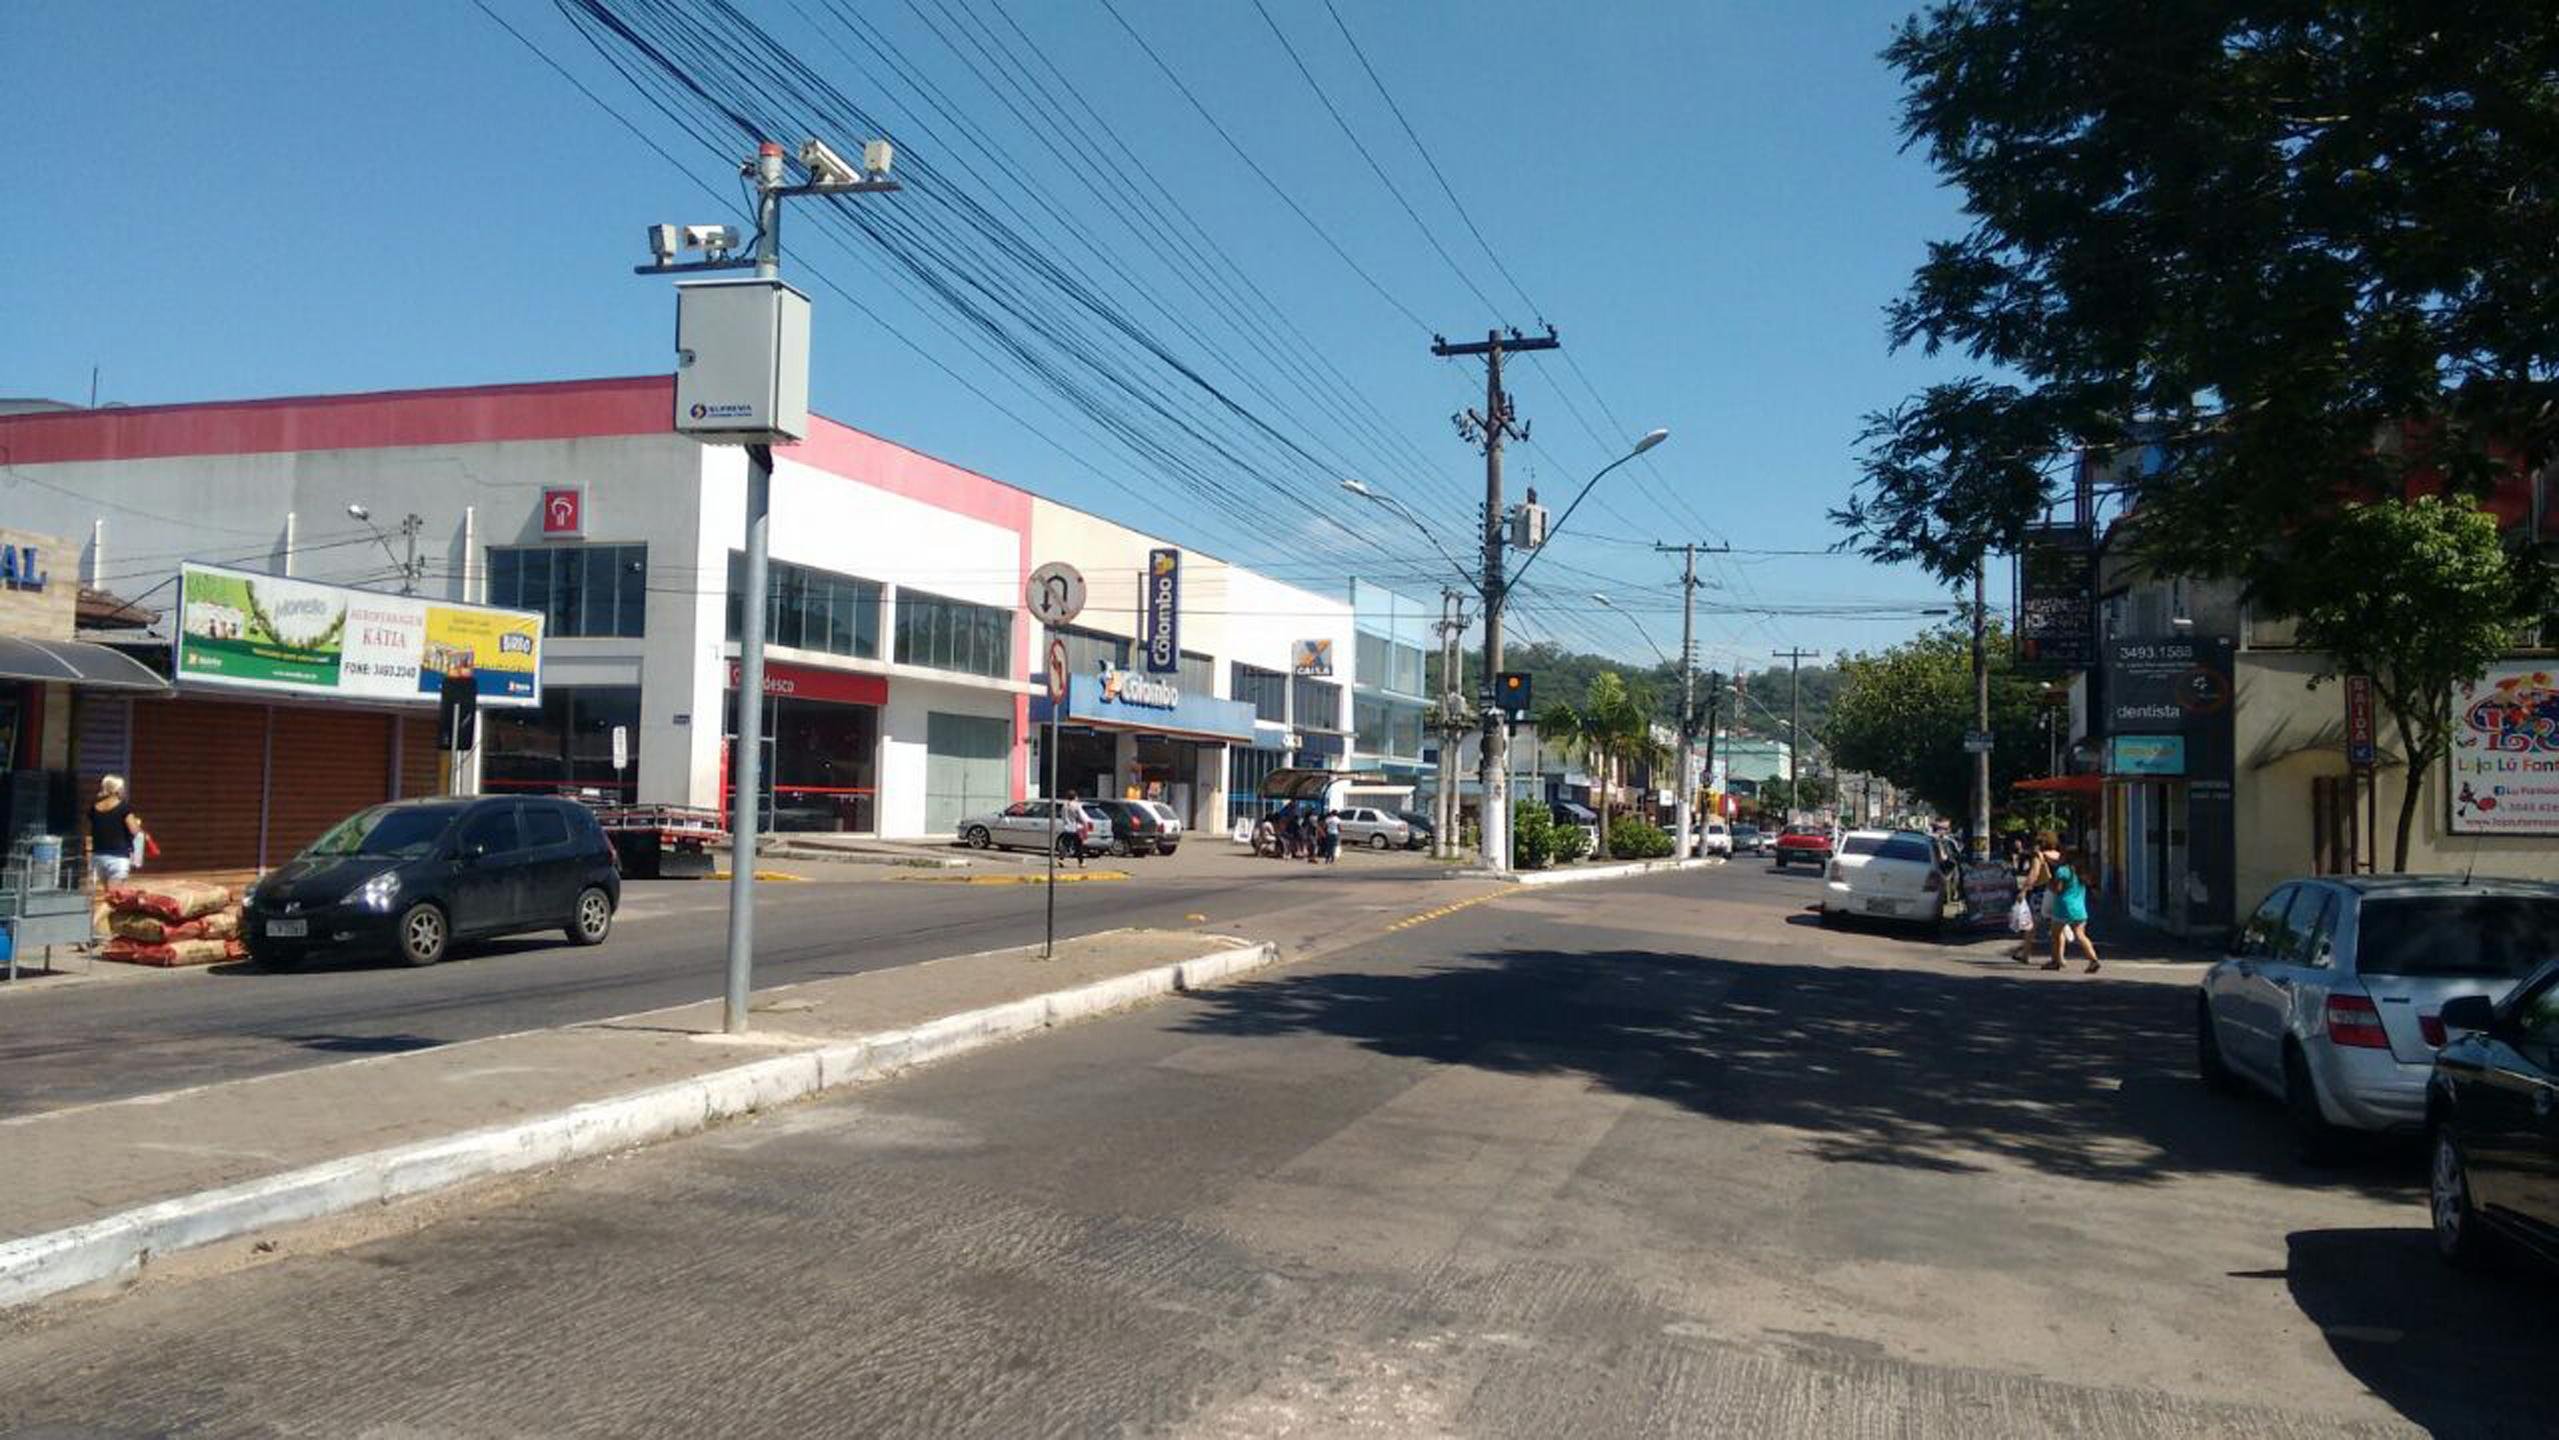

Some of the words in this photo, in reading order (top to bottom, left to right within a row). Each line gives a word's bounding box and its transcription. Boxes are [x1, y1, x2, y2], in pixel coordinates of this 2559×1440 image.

[1153, 577, 1172, 666] Colombo
[1122, 676, 1178, 708] Colombo
[2117, 704, 2180, 718] dentista
